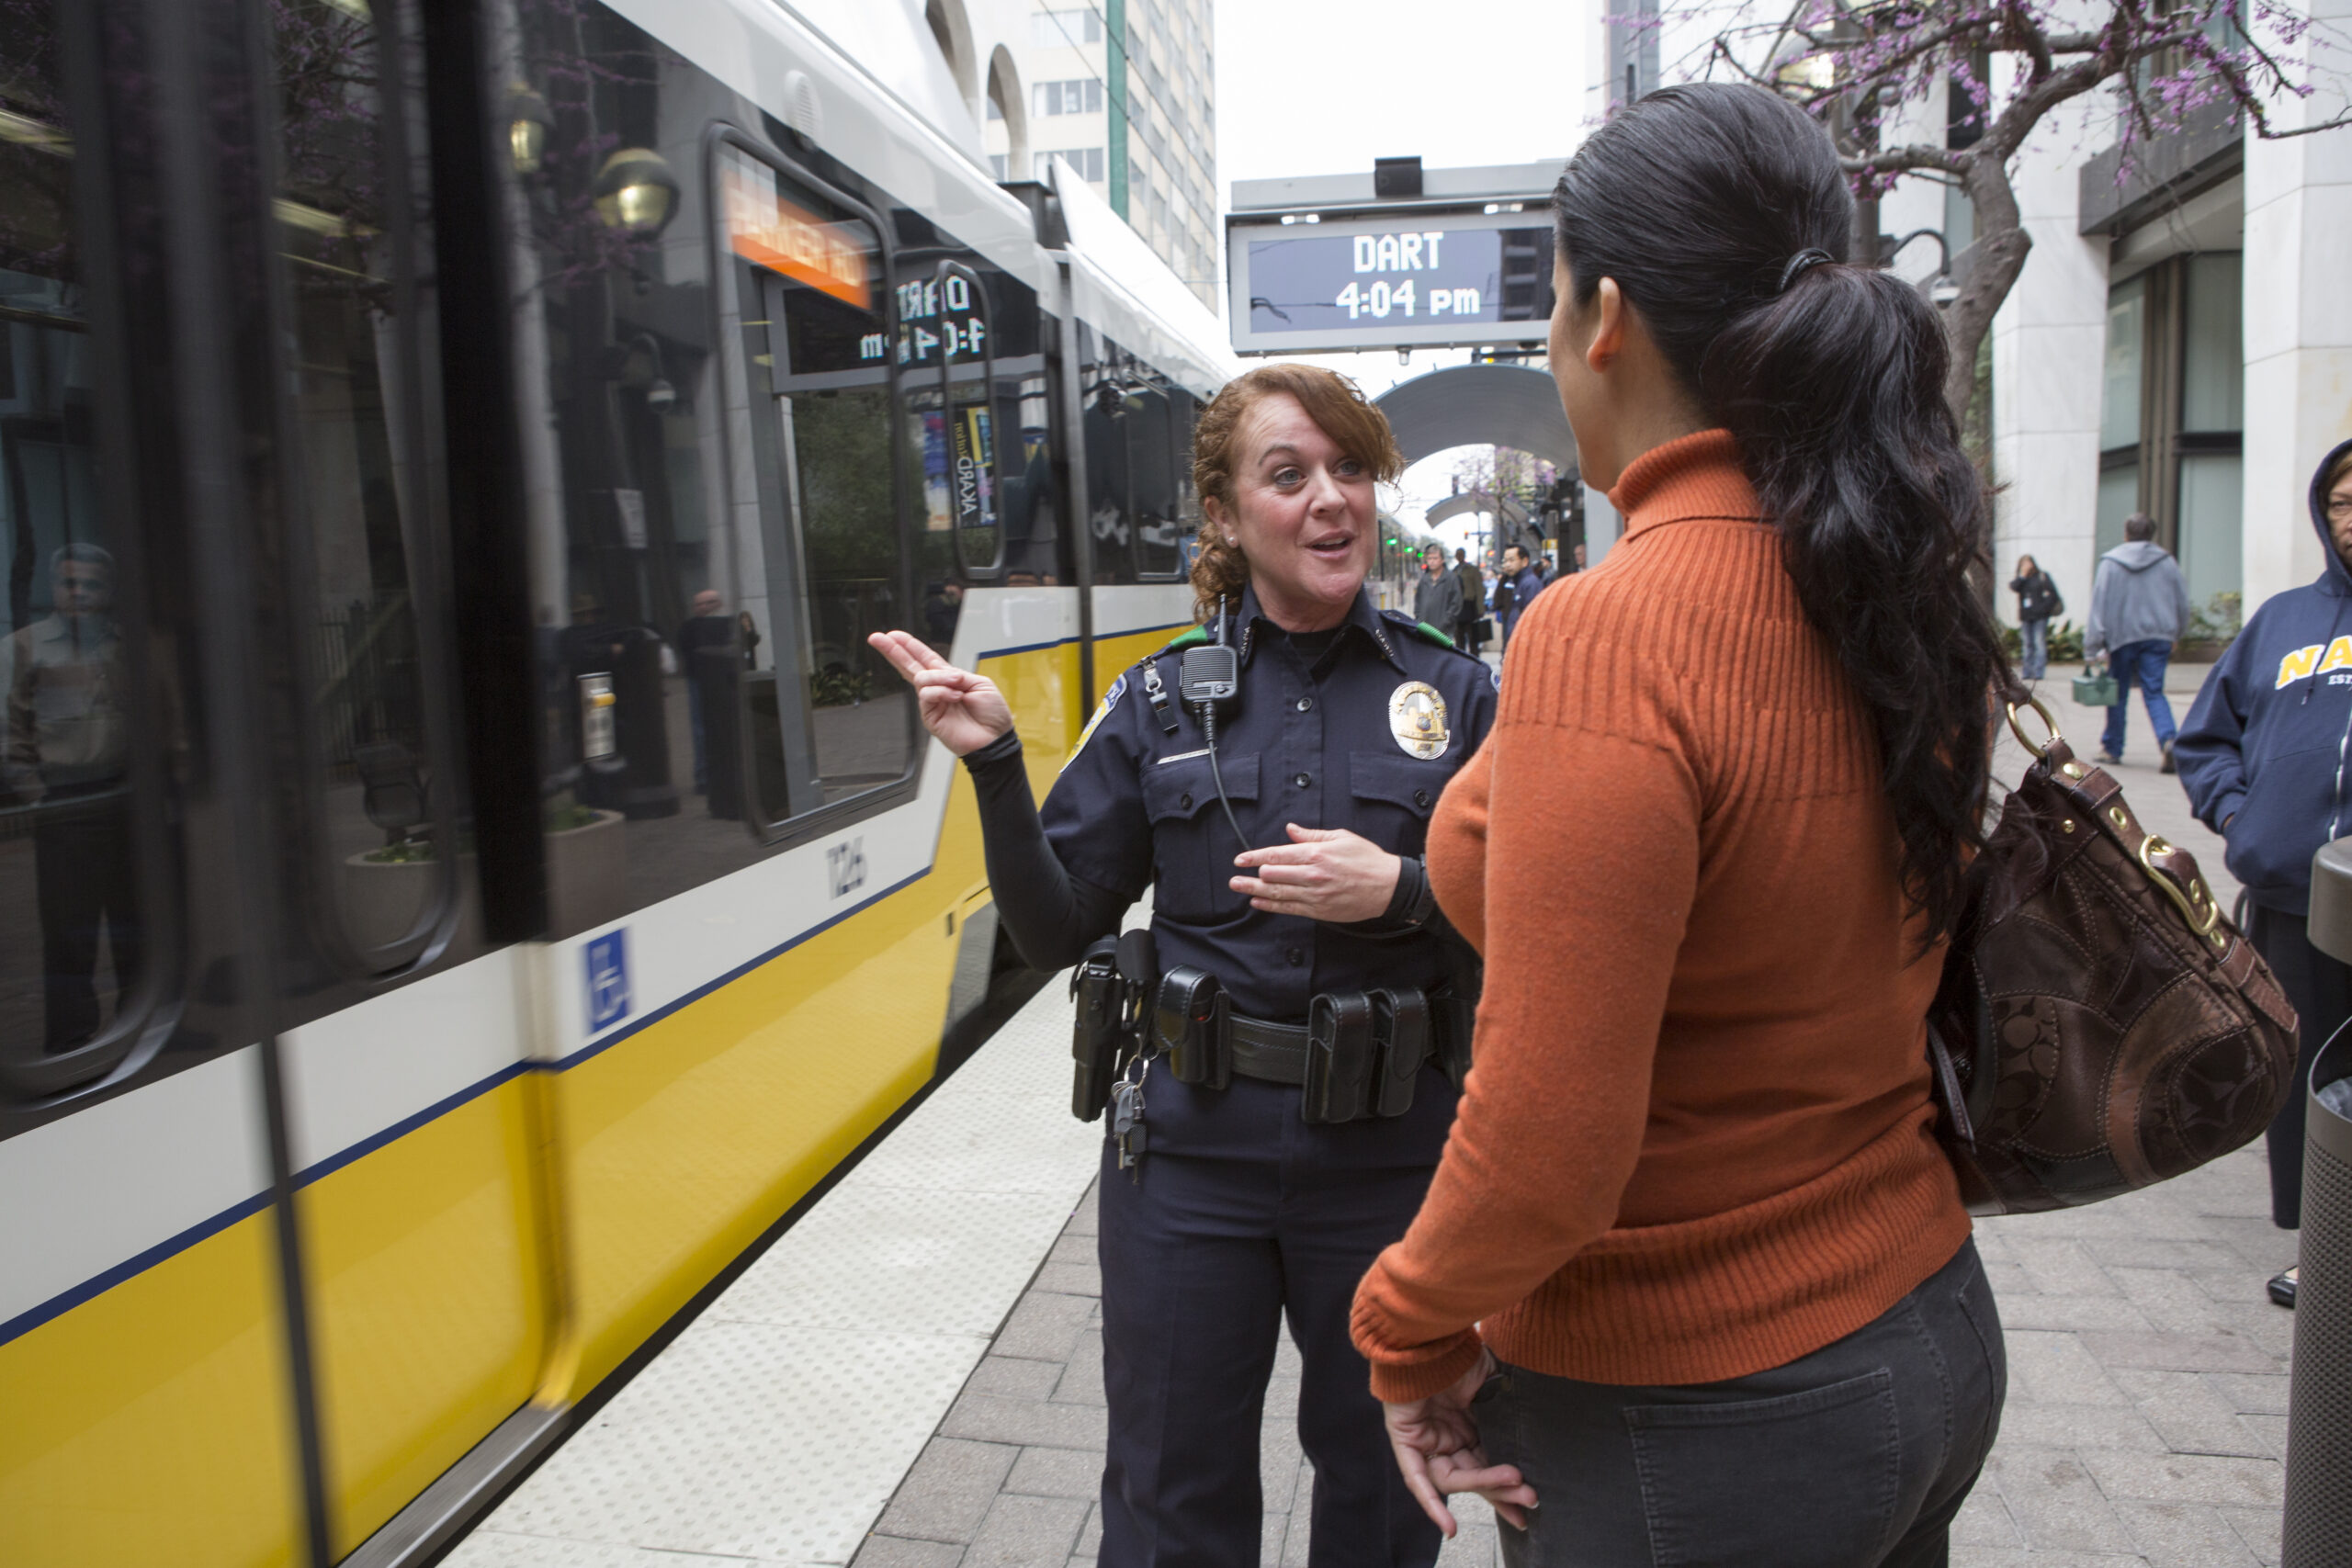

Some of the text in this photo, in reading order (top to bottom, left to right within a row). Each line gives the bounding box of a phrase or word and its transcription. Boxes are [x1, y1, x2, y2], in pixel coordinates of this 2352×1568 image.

[1353, 231, 1443, 273] DART
[1336, 279, 1480, 319] 4:04 pm
[2275, 635, 2352, 690] NA
